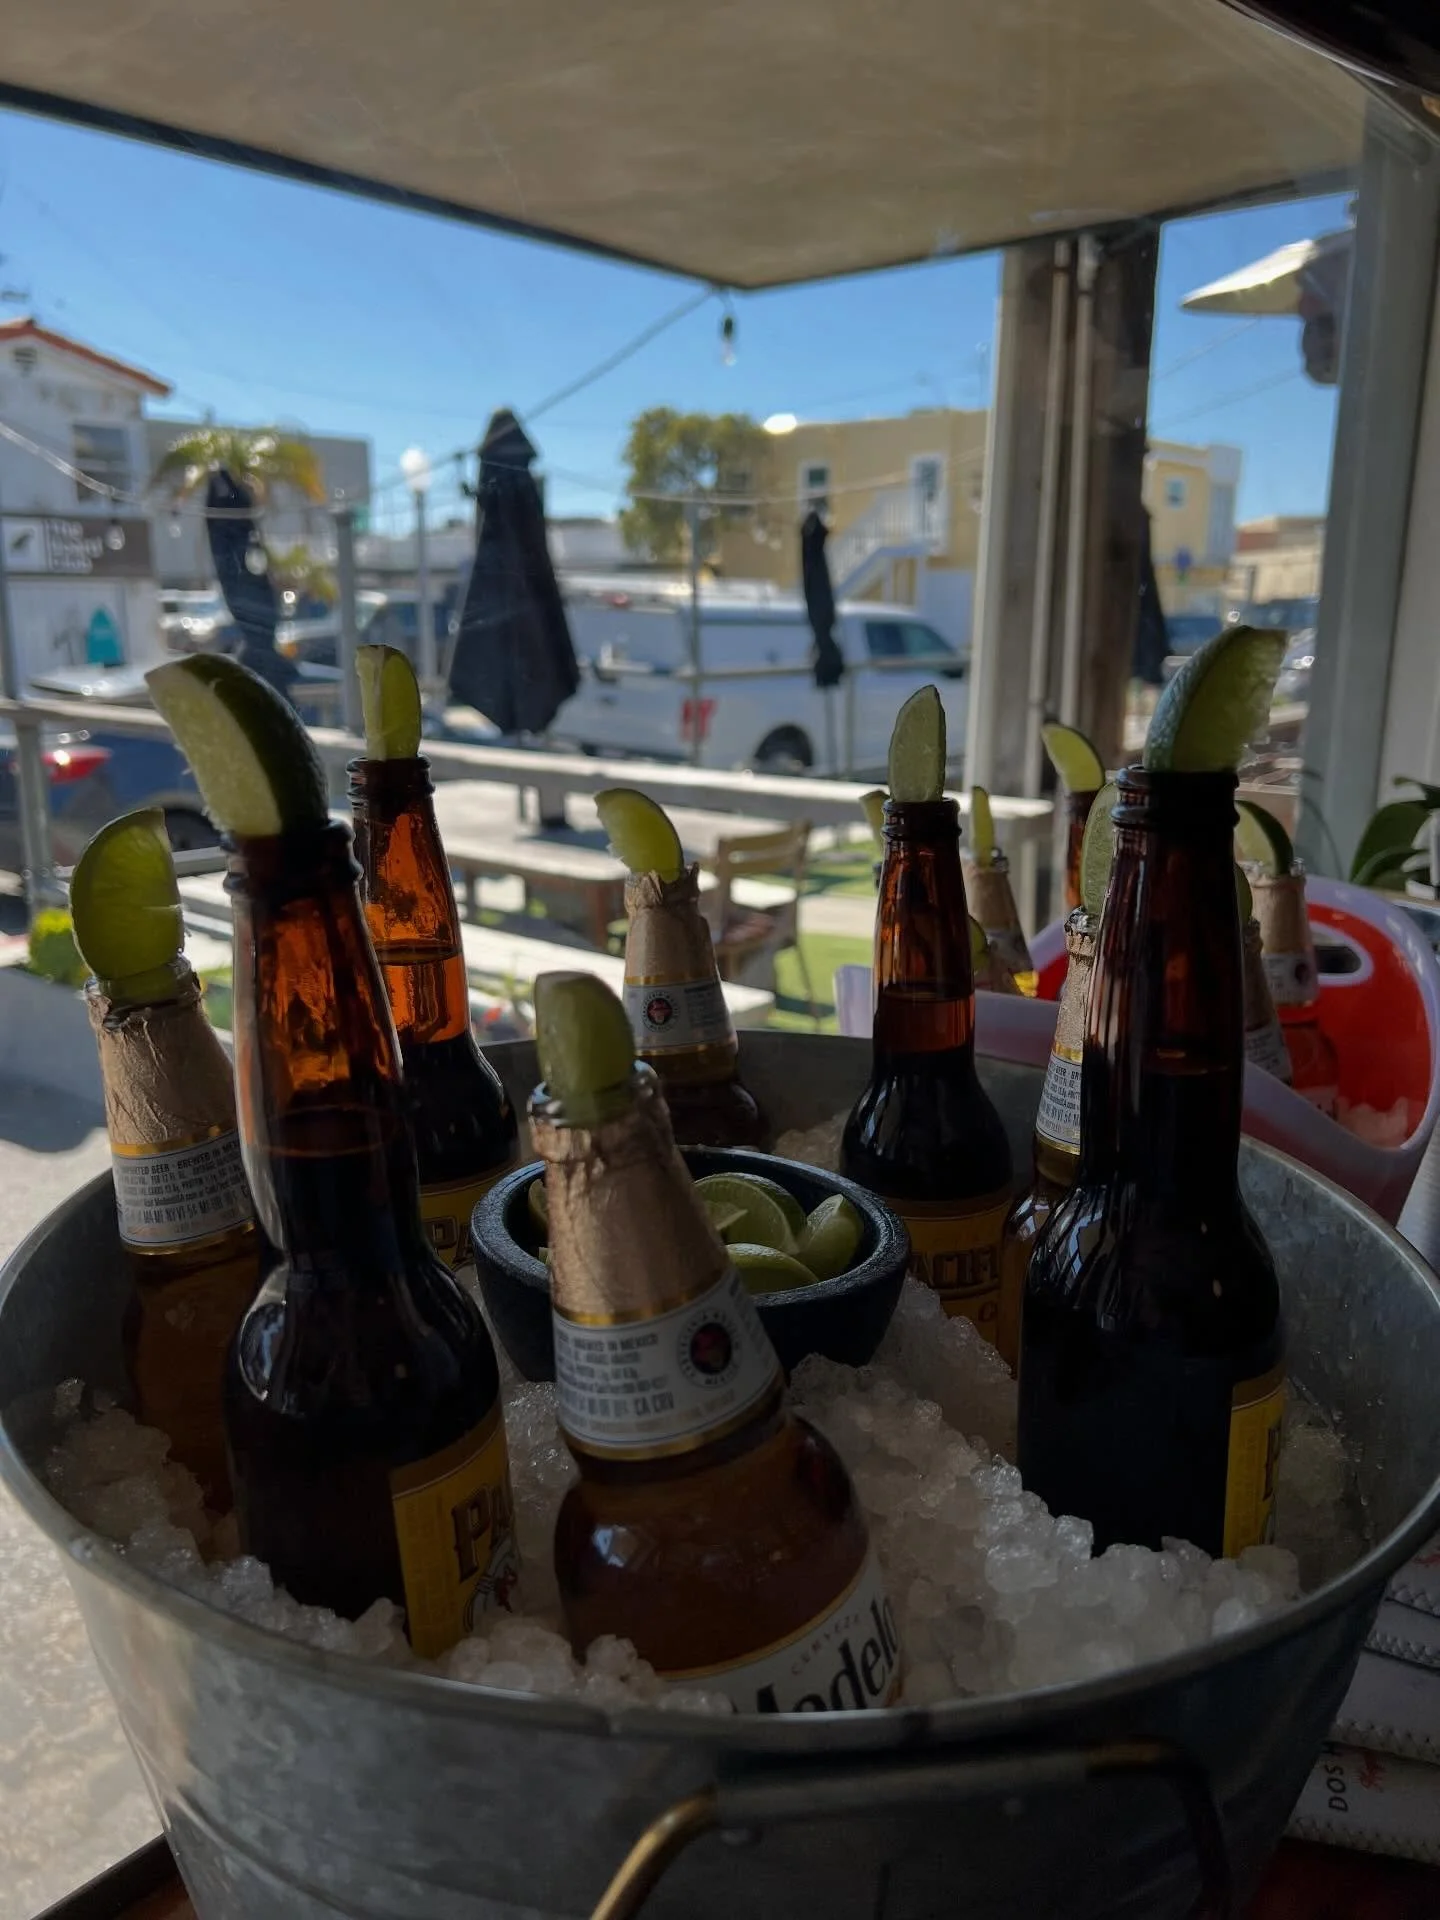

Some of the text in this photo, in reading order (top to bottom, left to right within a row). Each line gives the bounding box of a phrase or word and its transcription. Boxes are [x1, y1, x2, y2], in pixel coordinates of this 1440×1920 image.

[152, 1163, 170, 1175] BEER
[731, 1595, 899, 1713] delo
[1322, 1764, 1349, 1813] DOS
